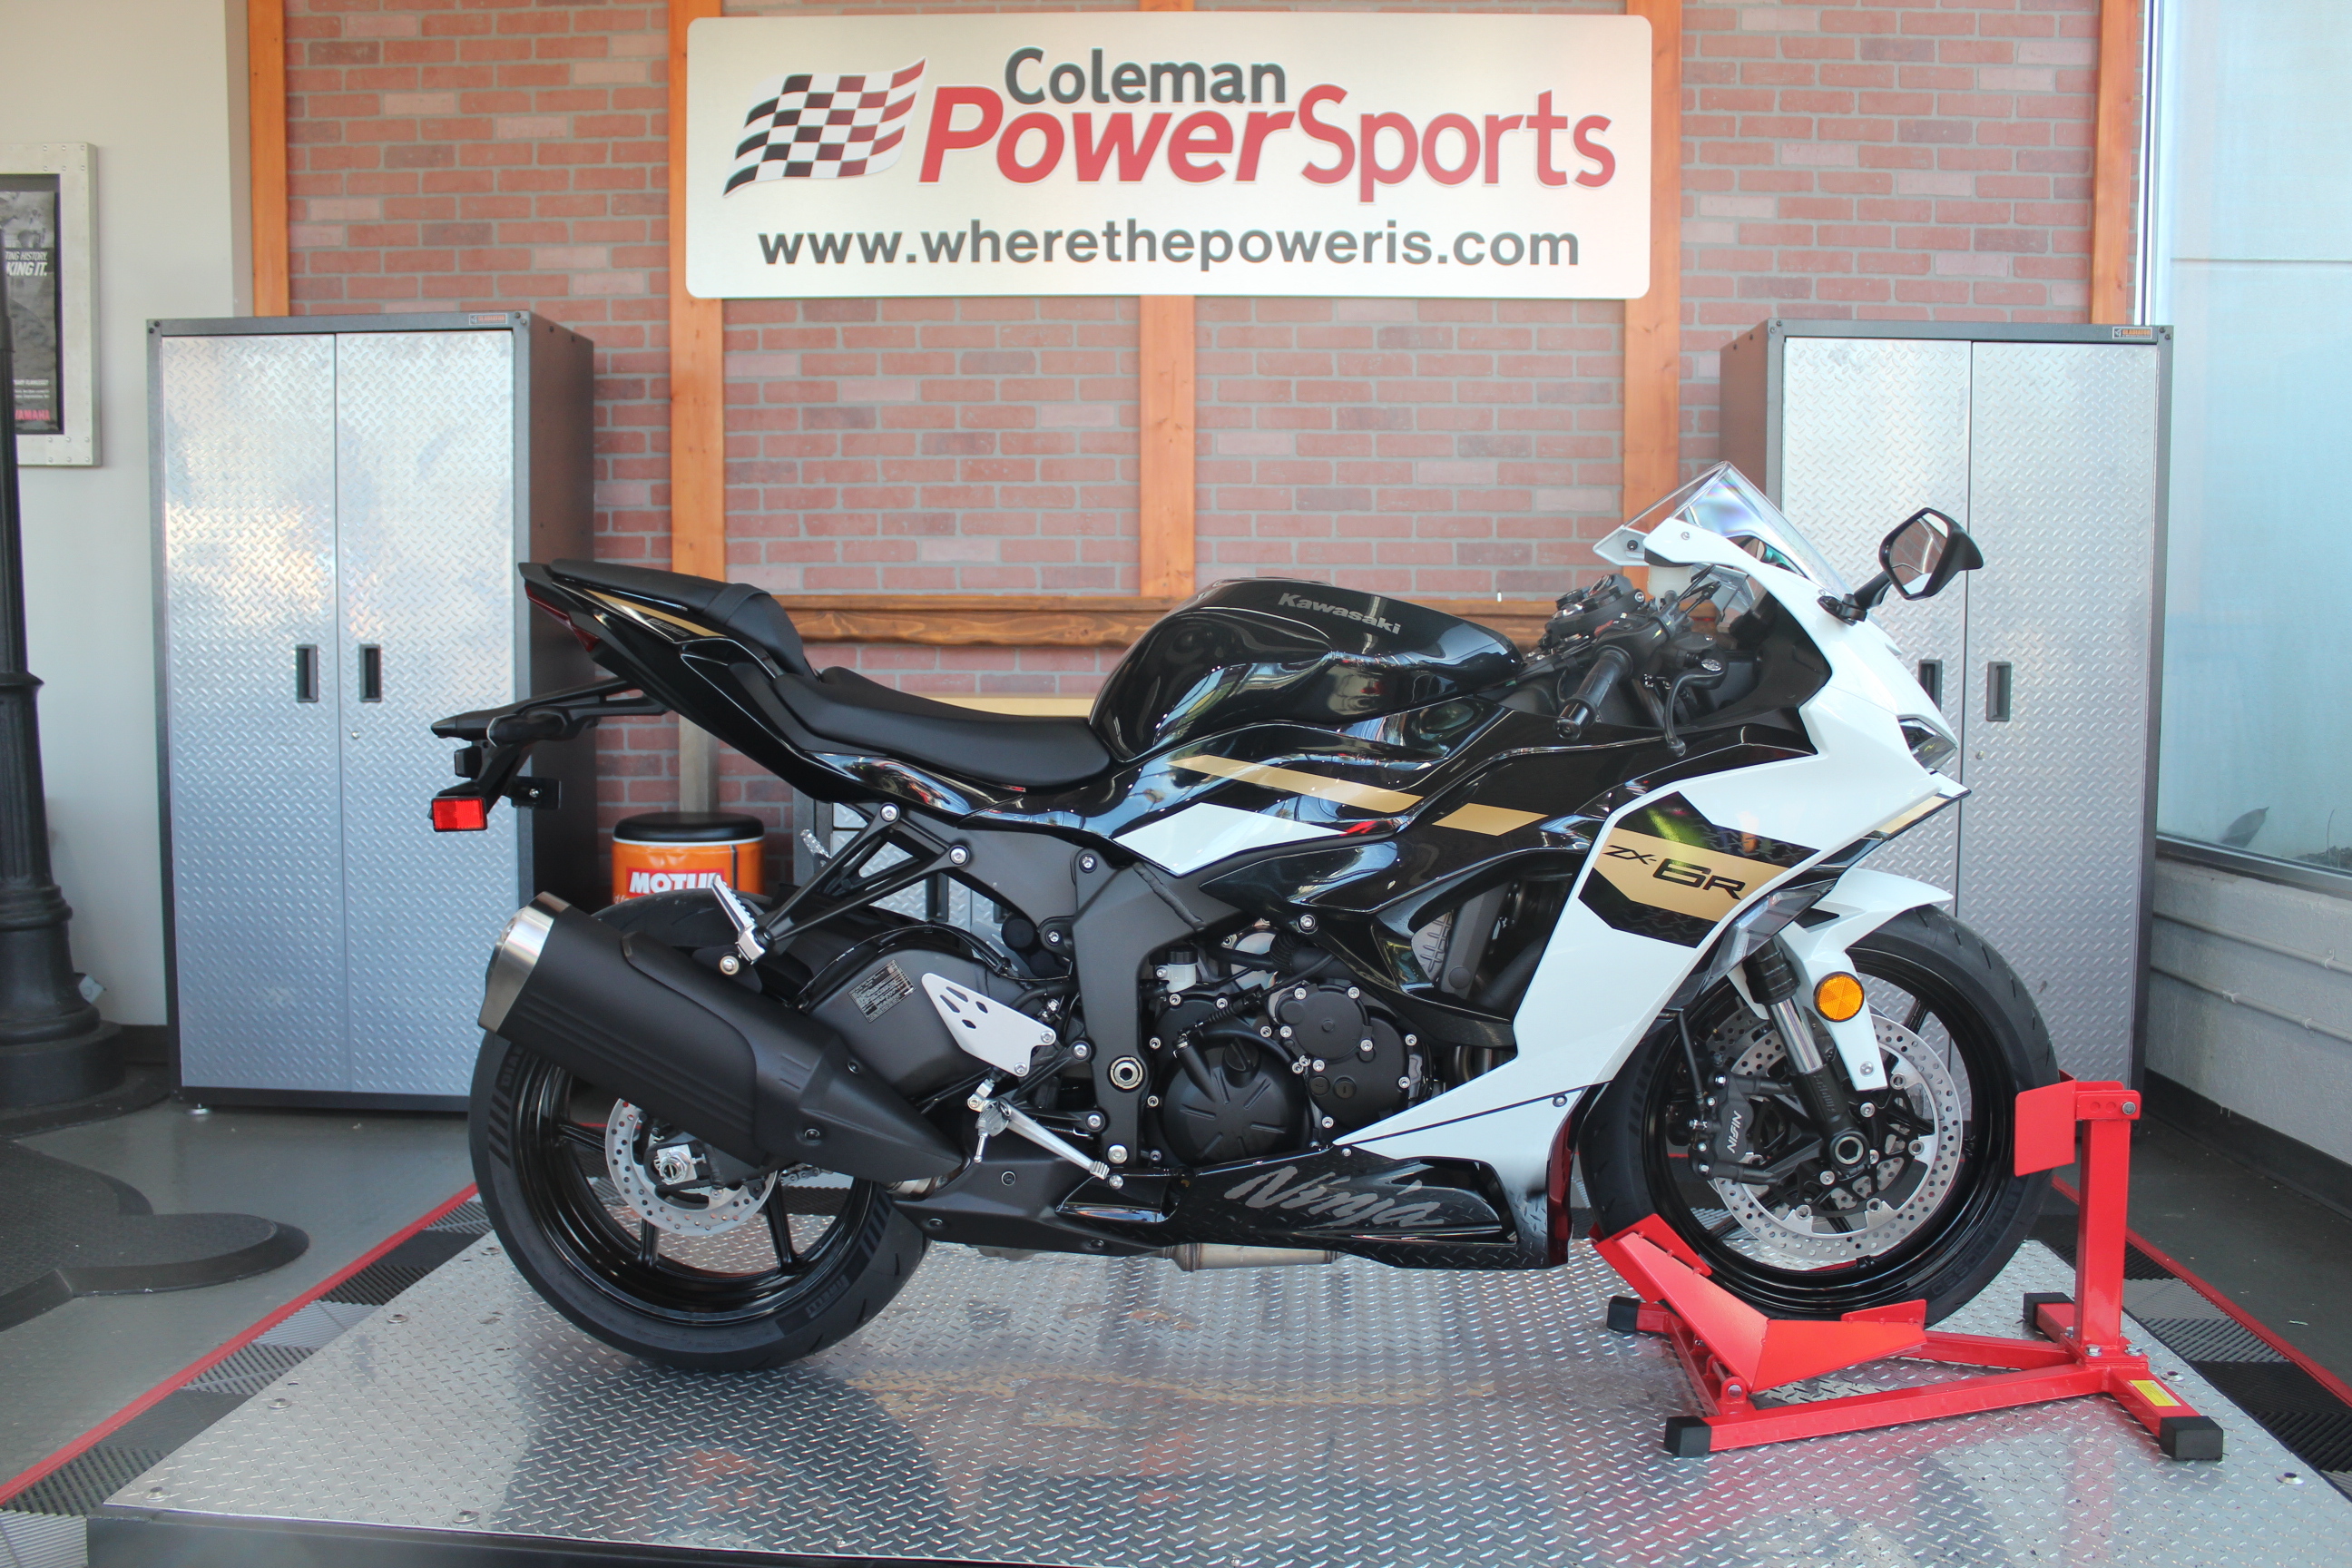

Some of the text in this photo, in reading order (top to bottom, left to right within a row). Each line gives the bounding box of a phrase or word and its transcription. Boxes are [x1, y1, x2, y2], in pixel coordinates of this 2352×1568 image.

[1004, 47, 1288, 104] Coleman
[918, 83, 1617, 203] PowerSports
[758, 220, 1580, 272] www.wherethepoweris.com
[1277, 593, 1402, 635] Kawasaki
[1223, 1165, 1446, 1230] Ninja
